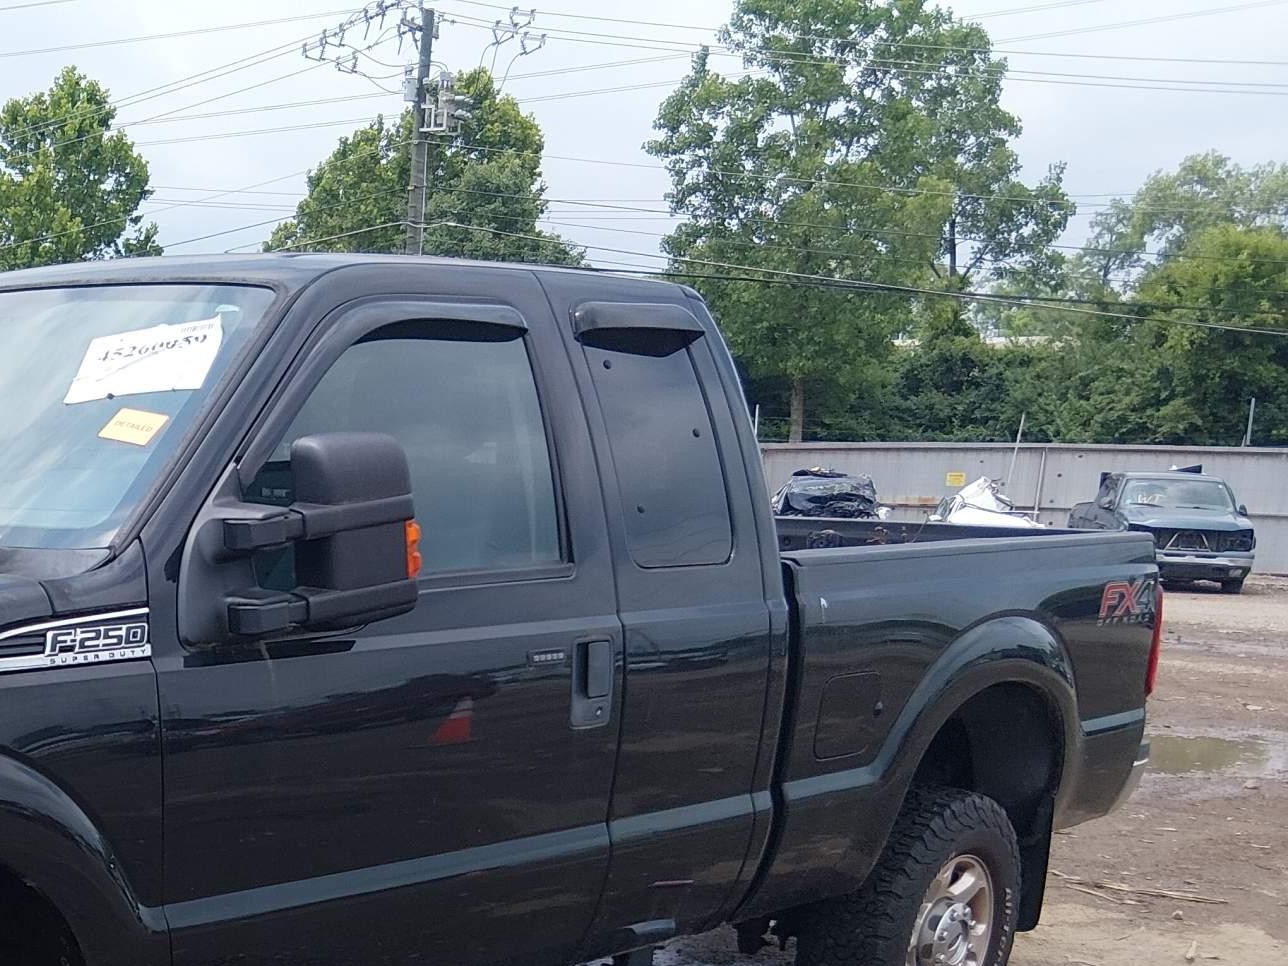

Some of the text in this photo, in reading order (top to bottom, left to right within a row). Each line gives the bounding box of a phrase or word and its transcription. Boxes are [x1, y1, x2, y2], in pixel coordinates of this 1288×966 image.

[1098, 580, 1155, 618] FX4
[44, 622, 149, 657] F-250
[49, 649, 146, 665] SUPER DUTY
